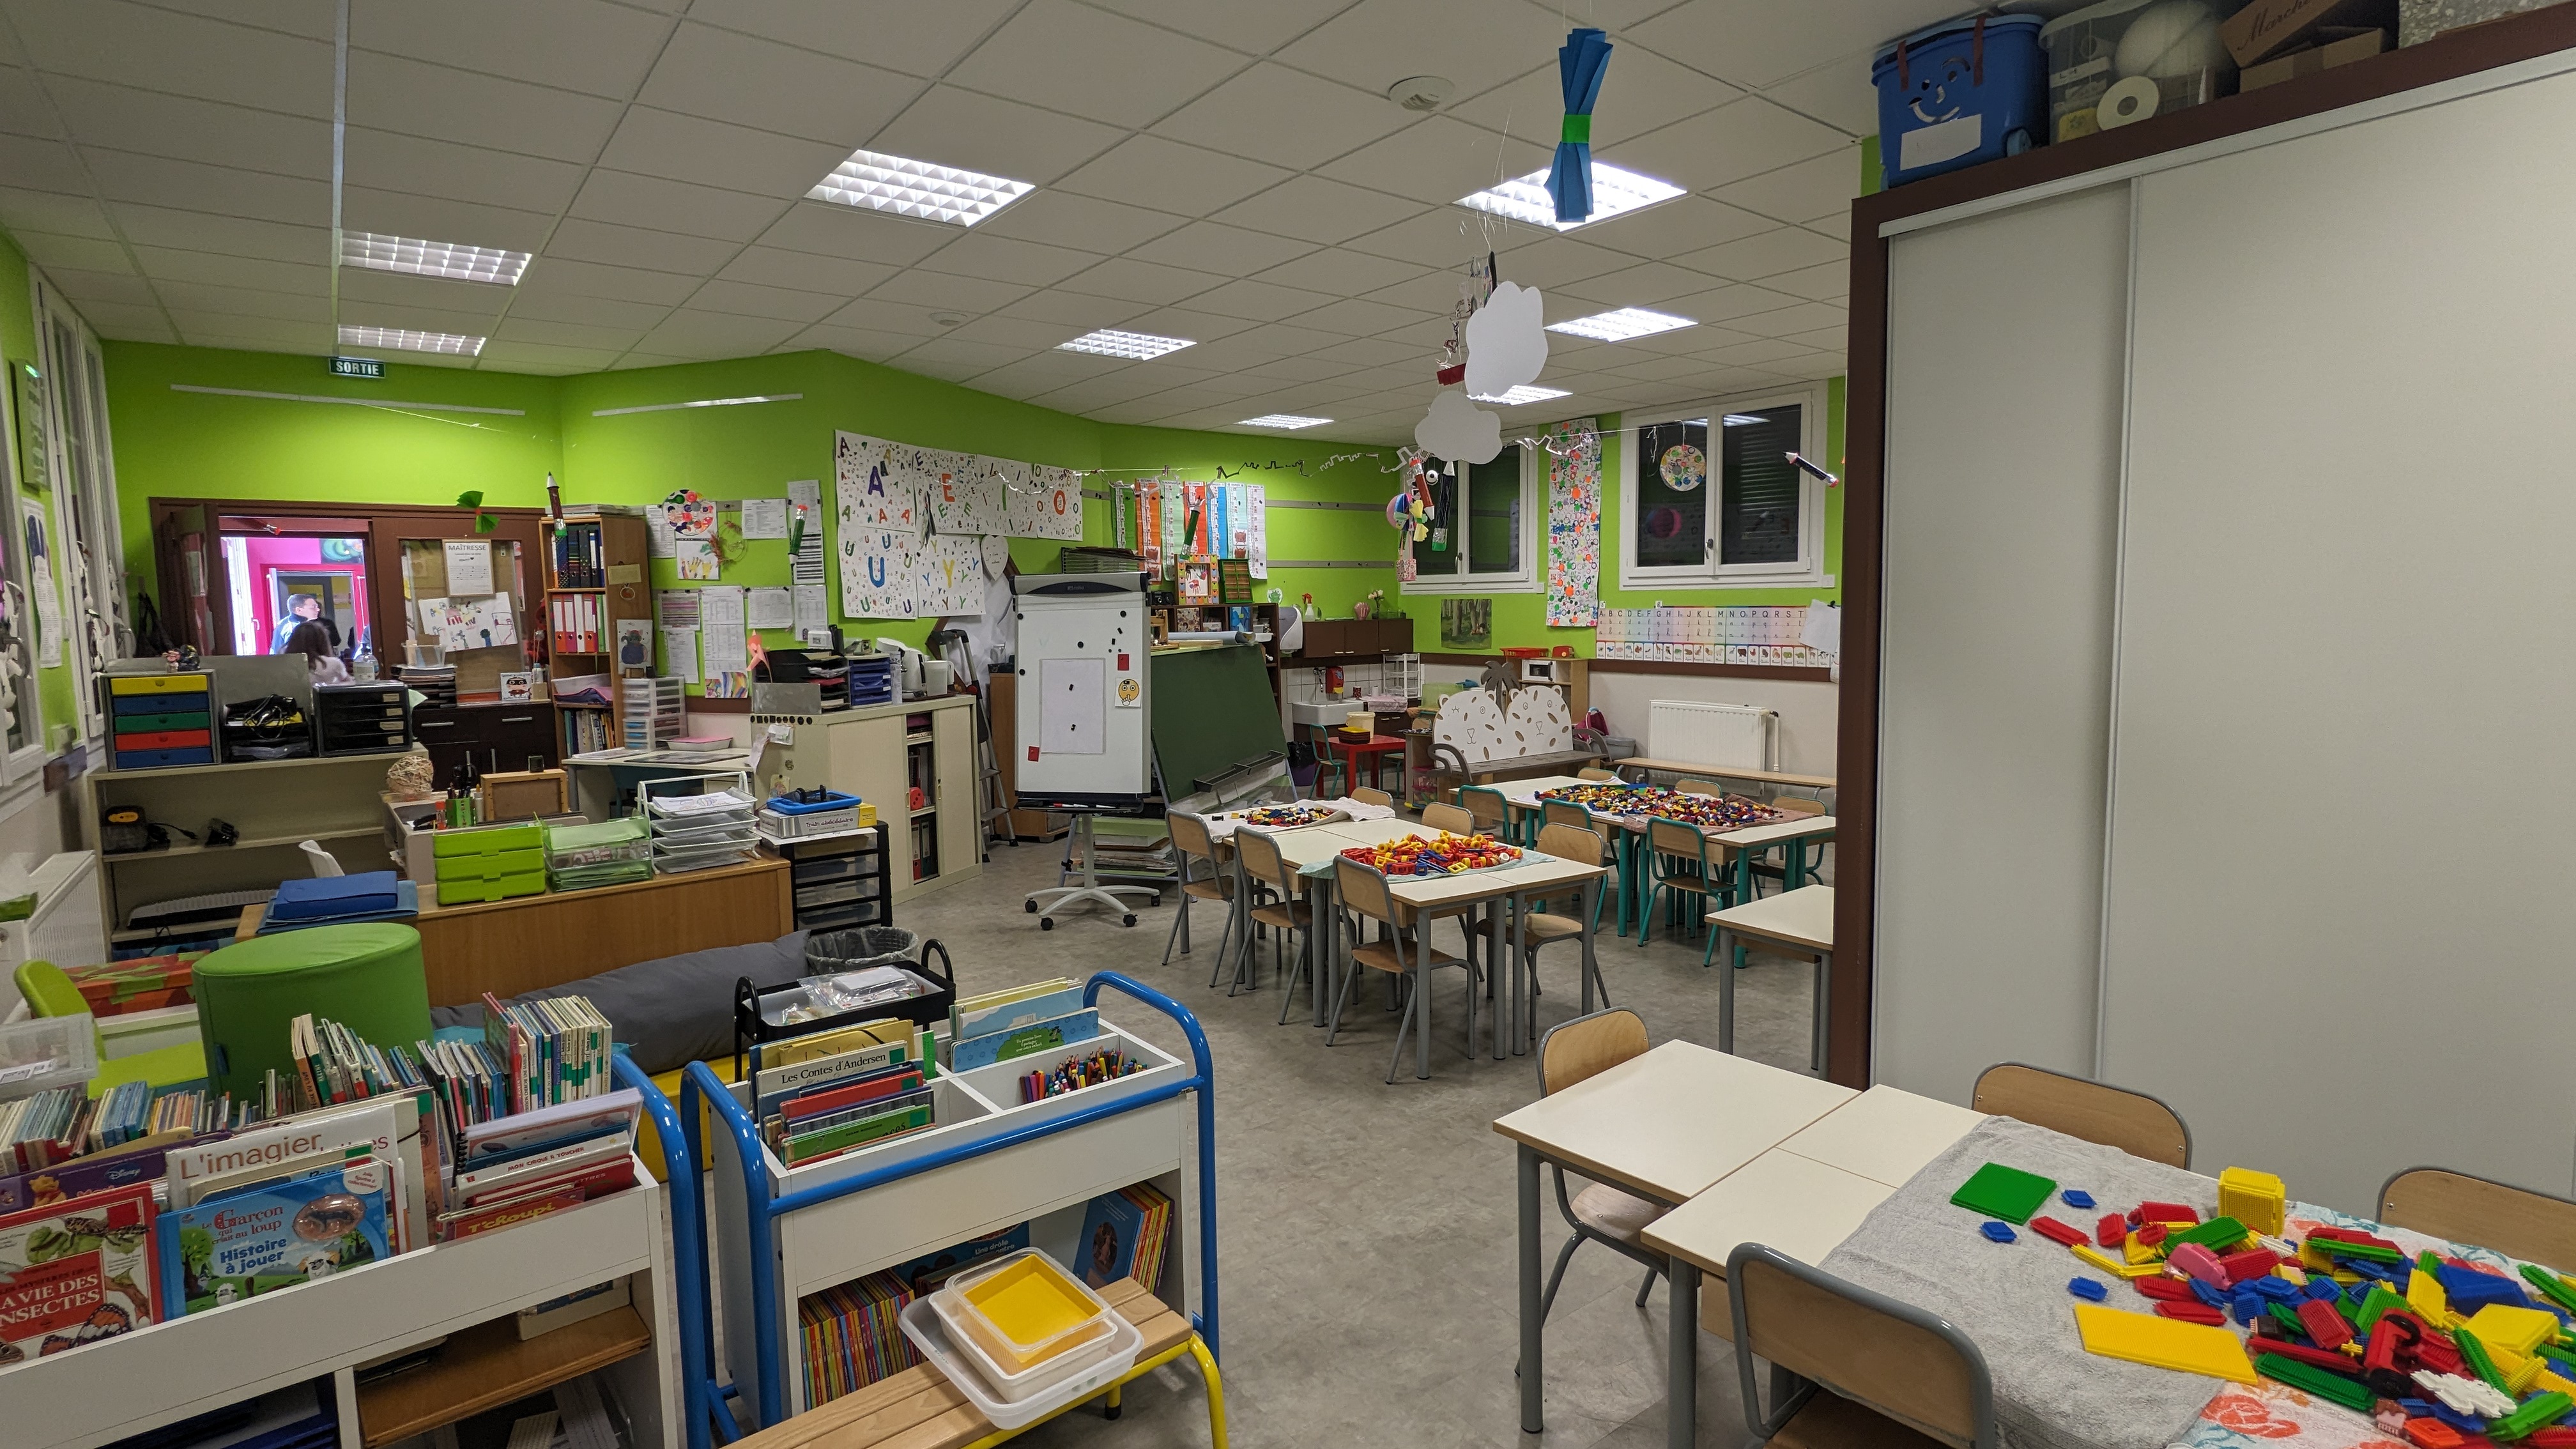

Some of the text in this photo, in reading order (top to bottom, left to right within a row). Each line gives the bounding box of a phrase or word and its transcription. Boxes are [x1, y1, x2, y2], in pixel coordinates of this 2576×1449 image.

[336, 361, 379, 375] SORTIE
[915, 450, 923, 466] E
[868, 466, 884, 498] A
[942, 473, 955, 502] E
[878, 508, 887, 523] A
[882, 533, 891, 549] U
[868, 556, 884, 588] U
[972, 557, 979, 571] Y
[923, 572, 930, 586] Y
[943, 559, 954, 588] Y
[860, 597, 870, 612] U
[903, 599, 912, 613] U
[959, 595, 966, 609] Y
[781, 1054, 886, 1084] Les Contes d'Andersen
[181, 1133, 321, 1179] L'imagier
[508, 1163, 524, 1171] MON
[527, 1156, 548, 1165] CIRQUE
[556, 1147, 584, 1158] TOUCHER
[109, 1169, 141, 1180] Disney
[213, 1206, 283, 1230] Garçon
[218, 1227, 232, 1237] qui
[251, 1220, 282, 1234] loup
[220, 1238, 287, 1263] Histoire
[990, 1239, 1008, 1250] drôle
[226, 1250, 284, 1275] à jouer
[18, 1285, 54, 1303] VIE
[58, 1274, 98, 1294] DES
[0, 1289, 100, 1328] NSECTES
